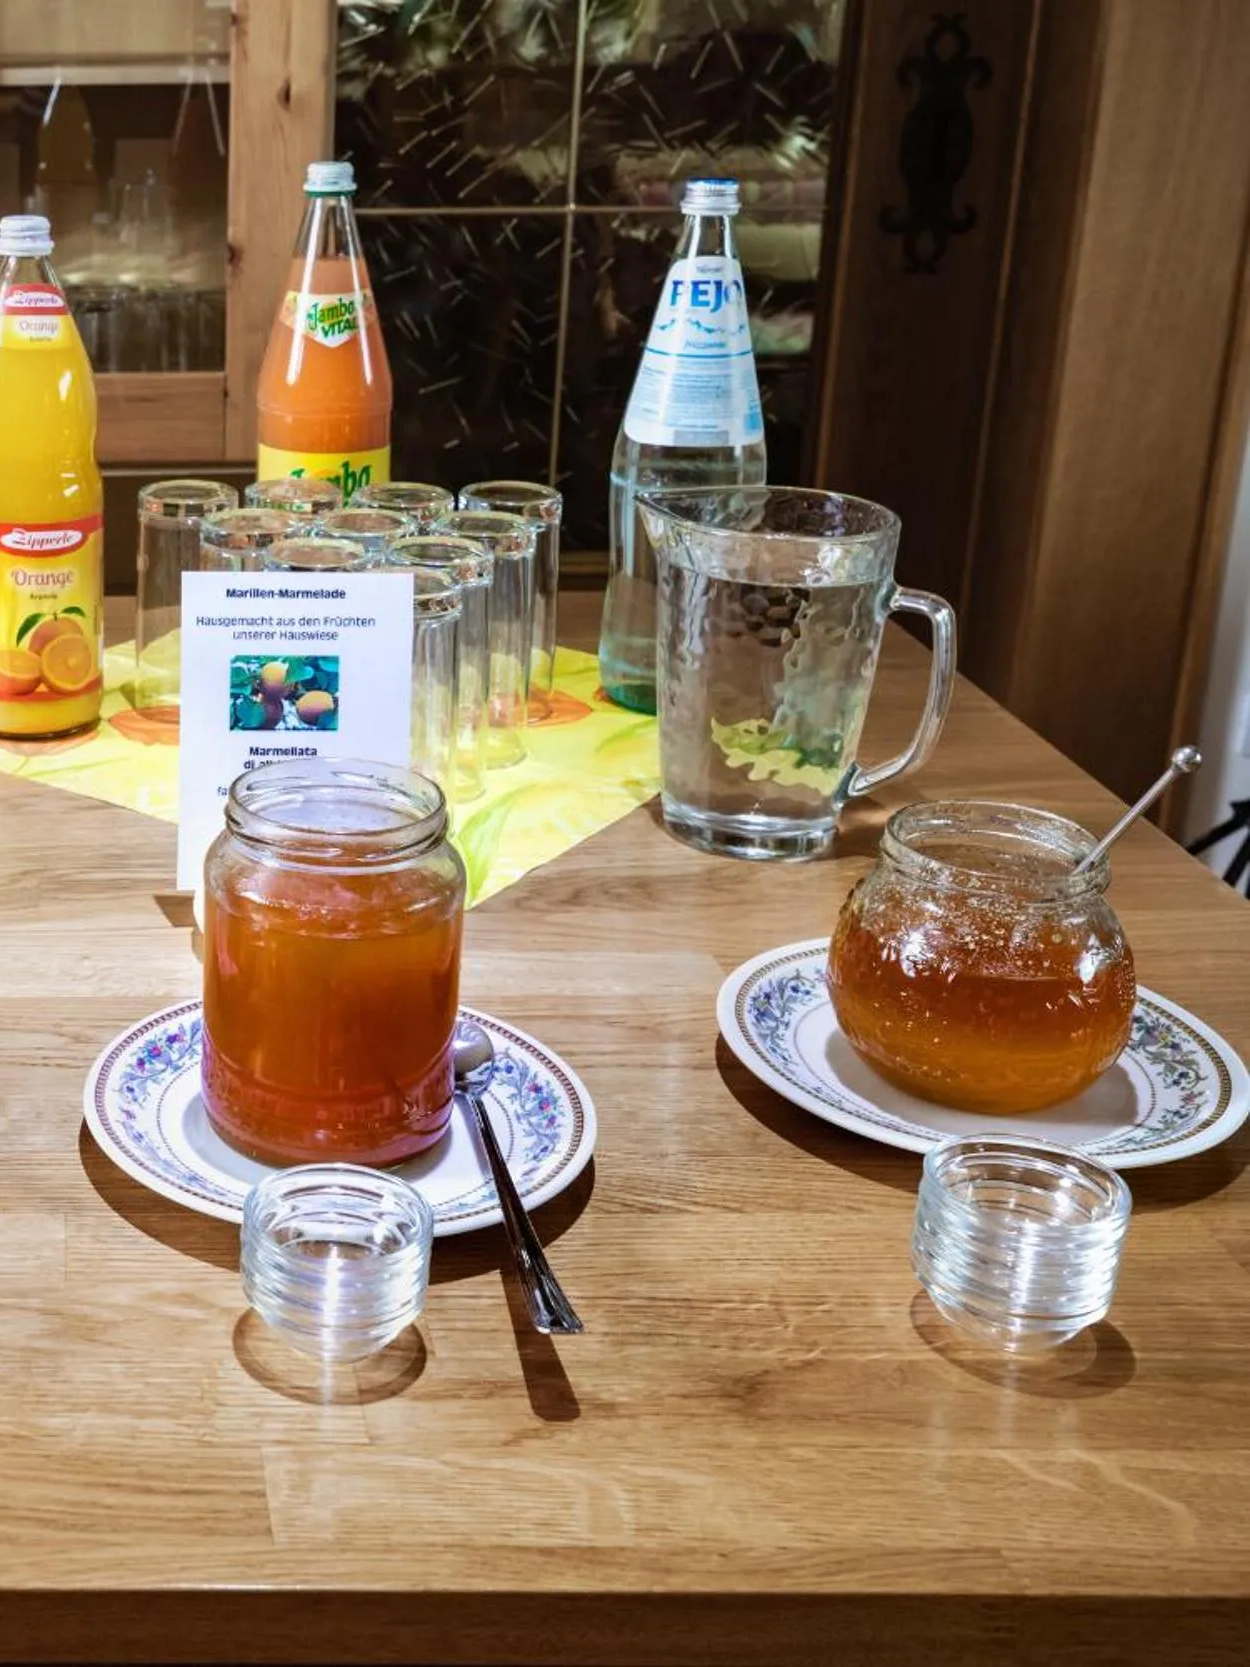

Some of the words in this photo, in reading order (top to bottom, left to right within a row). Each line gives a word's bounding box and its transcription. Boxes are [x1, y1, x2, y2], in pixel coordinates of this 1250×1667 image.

[307, 296, 355, 330] Jambo
[10, 568, 75, 588] Orange
[225, 588, 347, 600] Marillen-Marmelade
[195, 615, 273, 628] Hausgemacht
[276, 616, 296, 627] aus
[298, 615, 321, 627] den
[323, 615, 376, 628] Früchten
[232, 630, 277, 641] unserer
[279, 629, 339, 641] Hauswiese
[249, 746, 318, 757] Marmellata
